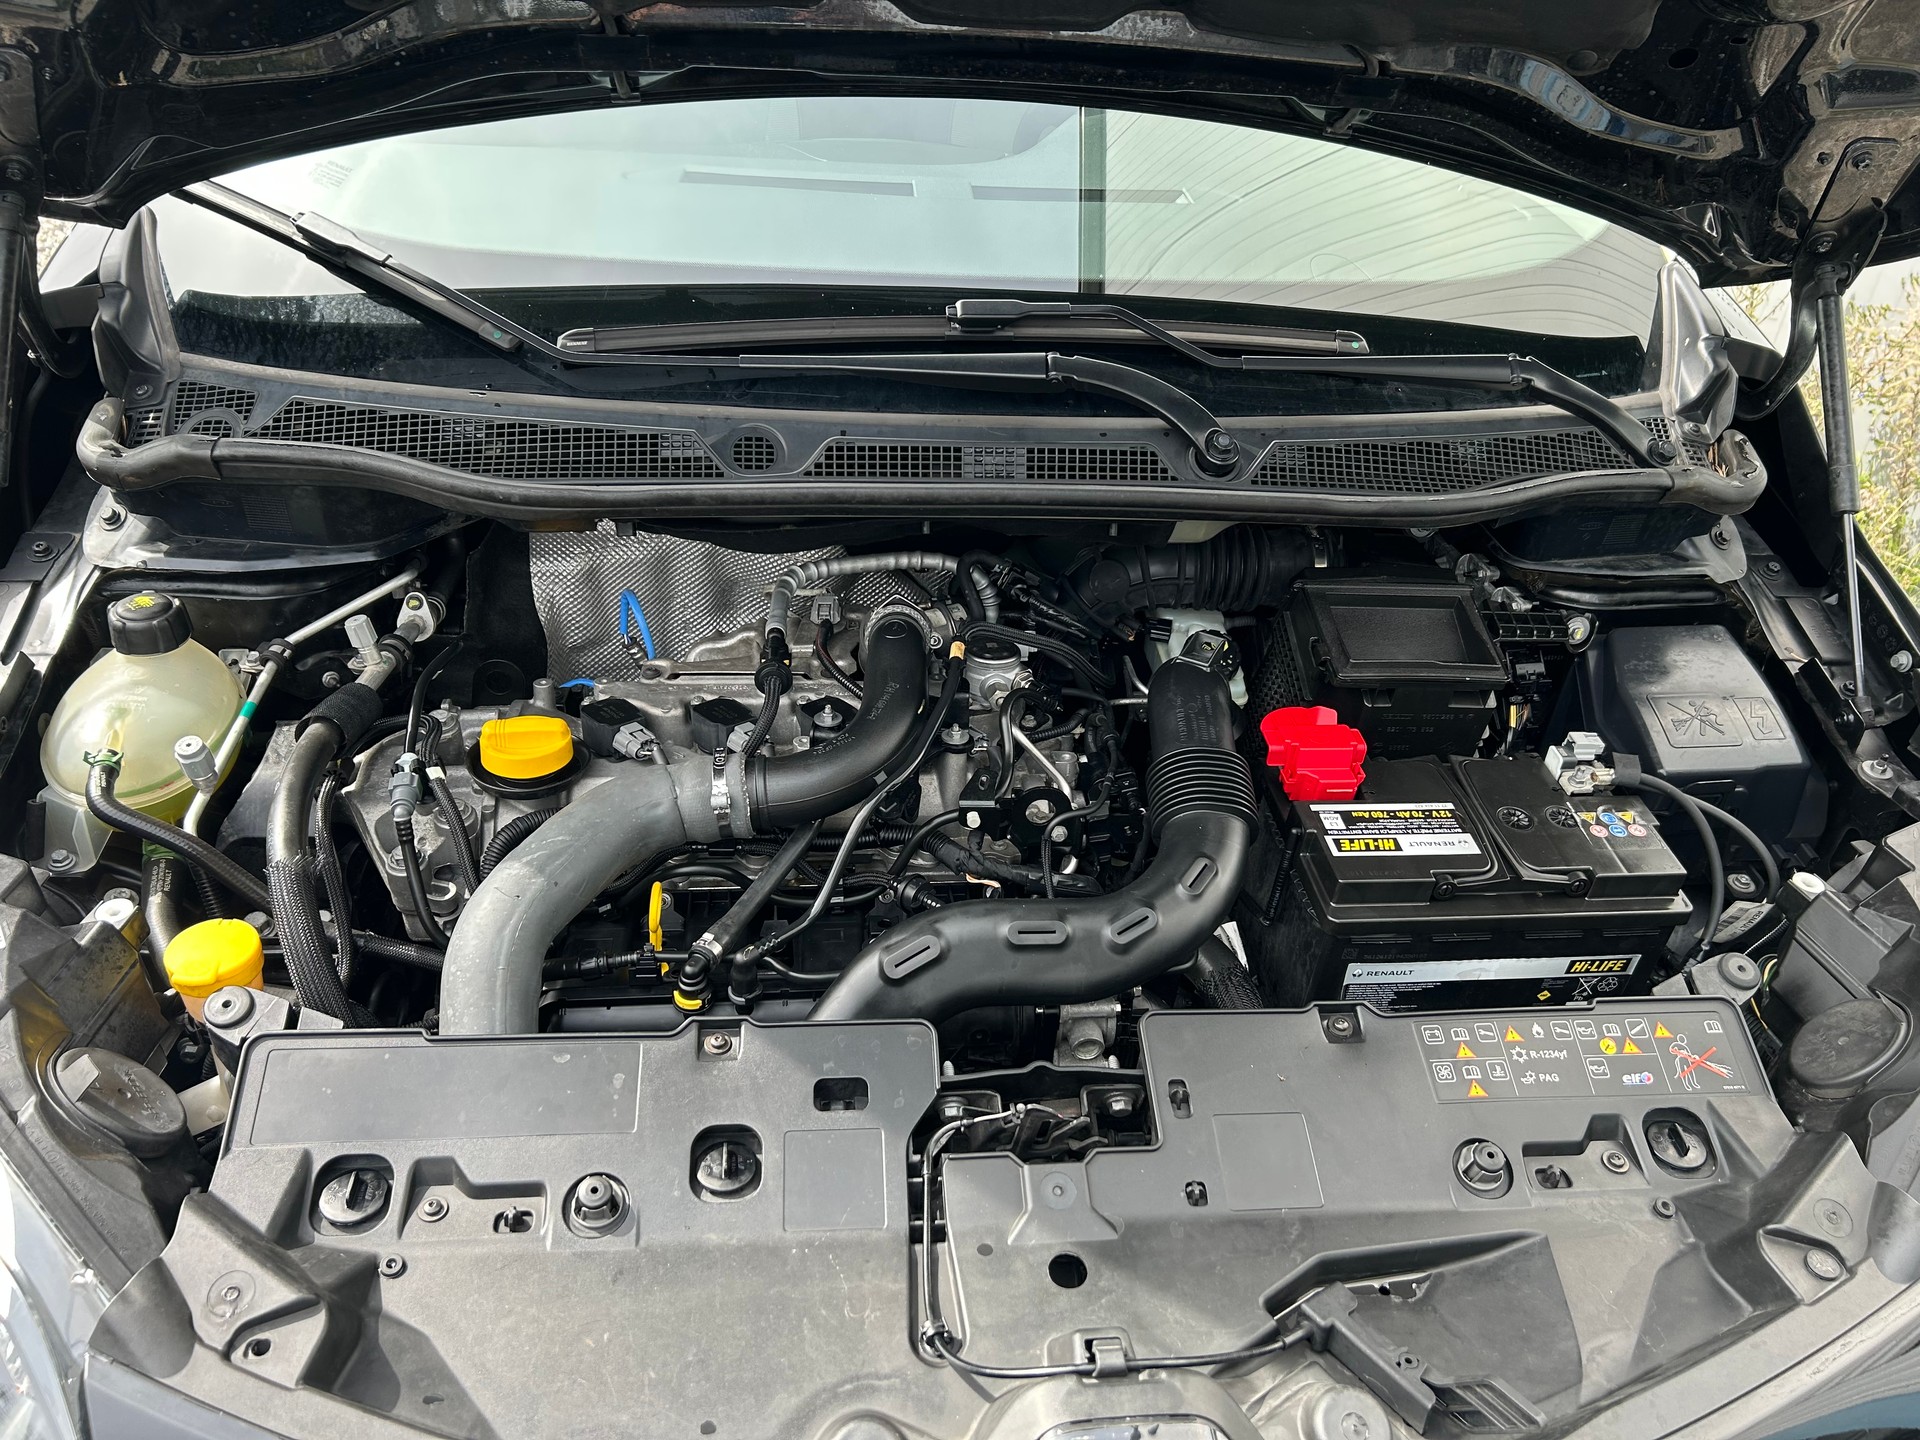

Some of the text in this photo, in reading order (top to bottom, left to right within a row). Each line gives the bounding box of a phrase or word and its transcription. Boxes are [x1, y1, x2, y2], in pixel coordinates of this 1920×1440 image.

[1371, 811, 1388, 819] 760
[1411, 810, 1423, 818] 70
[1431, 810, 1453, 818] 12V
[1408, 839, 1456, 848] RENAULT
[1739, 910, 1764, 932] RENAULT
[1529, 1048, 1569, 1062] R-1234yf
[1538, 1072, 1560, 1084] PAG
